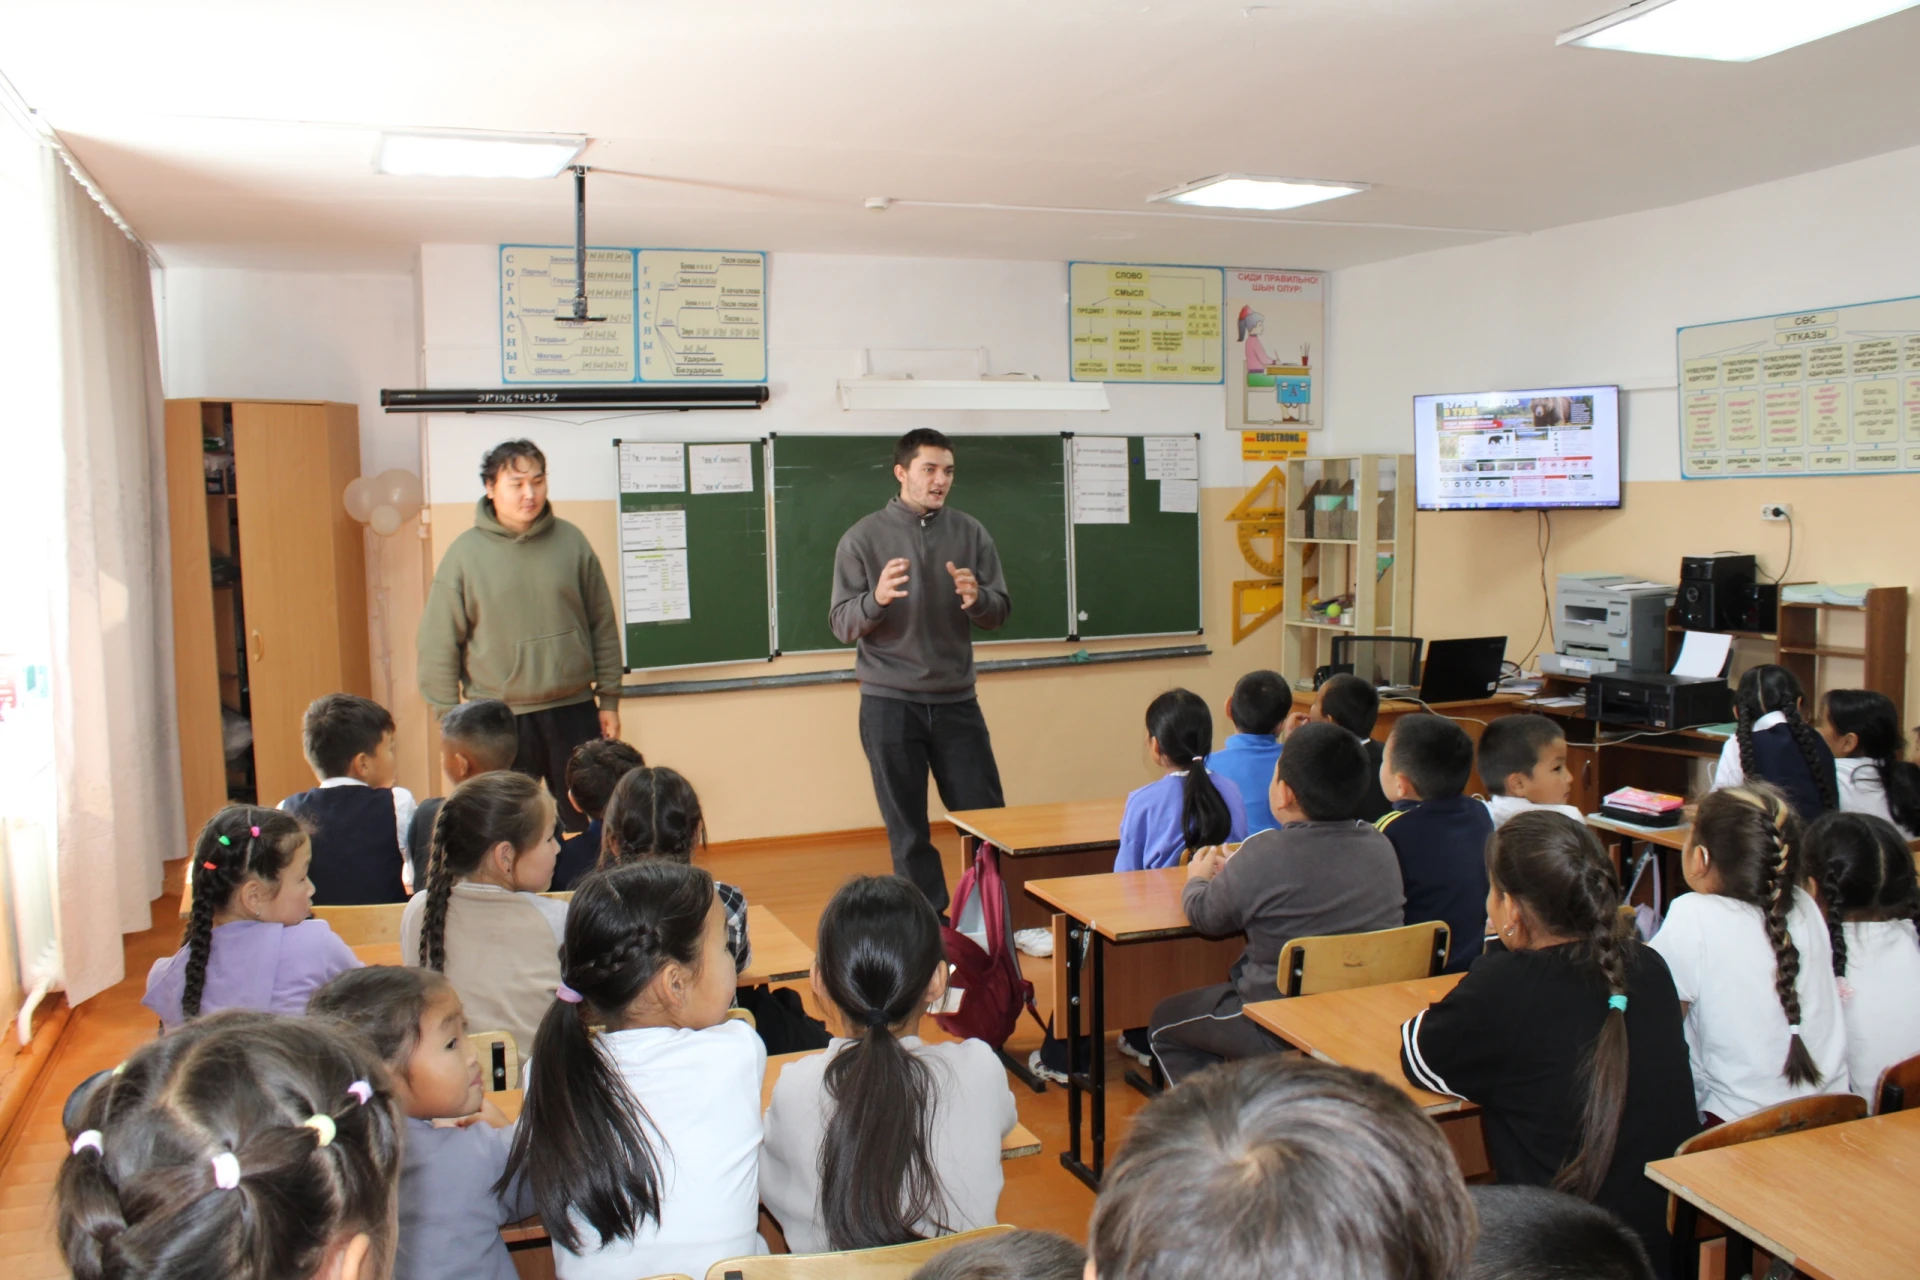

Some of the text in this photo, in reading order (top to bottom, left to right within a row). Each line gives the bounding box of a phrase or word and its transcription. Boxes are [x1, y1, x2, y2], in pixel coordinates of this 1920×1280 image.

[1115, 271, 1143, 280] СЛОВО
[1237, 273, 1319, 284] СИДИ ПРАВИЛЬНО!
[1252, 284, 1275, 292] ШЫН
[1114, 289, 1144, 297] СМЫСЛ
[1256, 432, 1299, 442] EDUSTRONG
